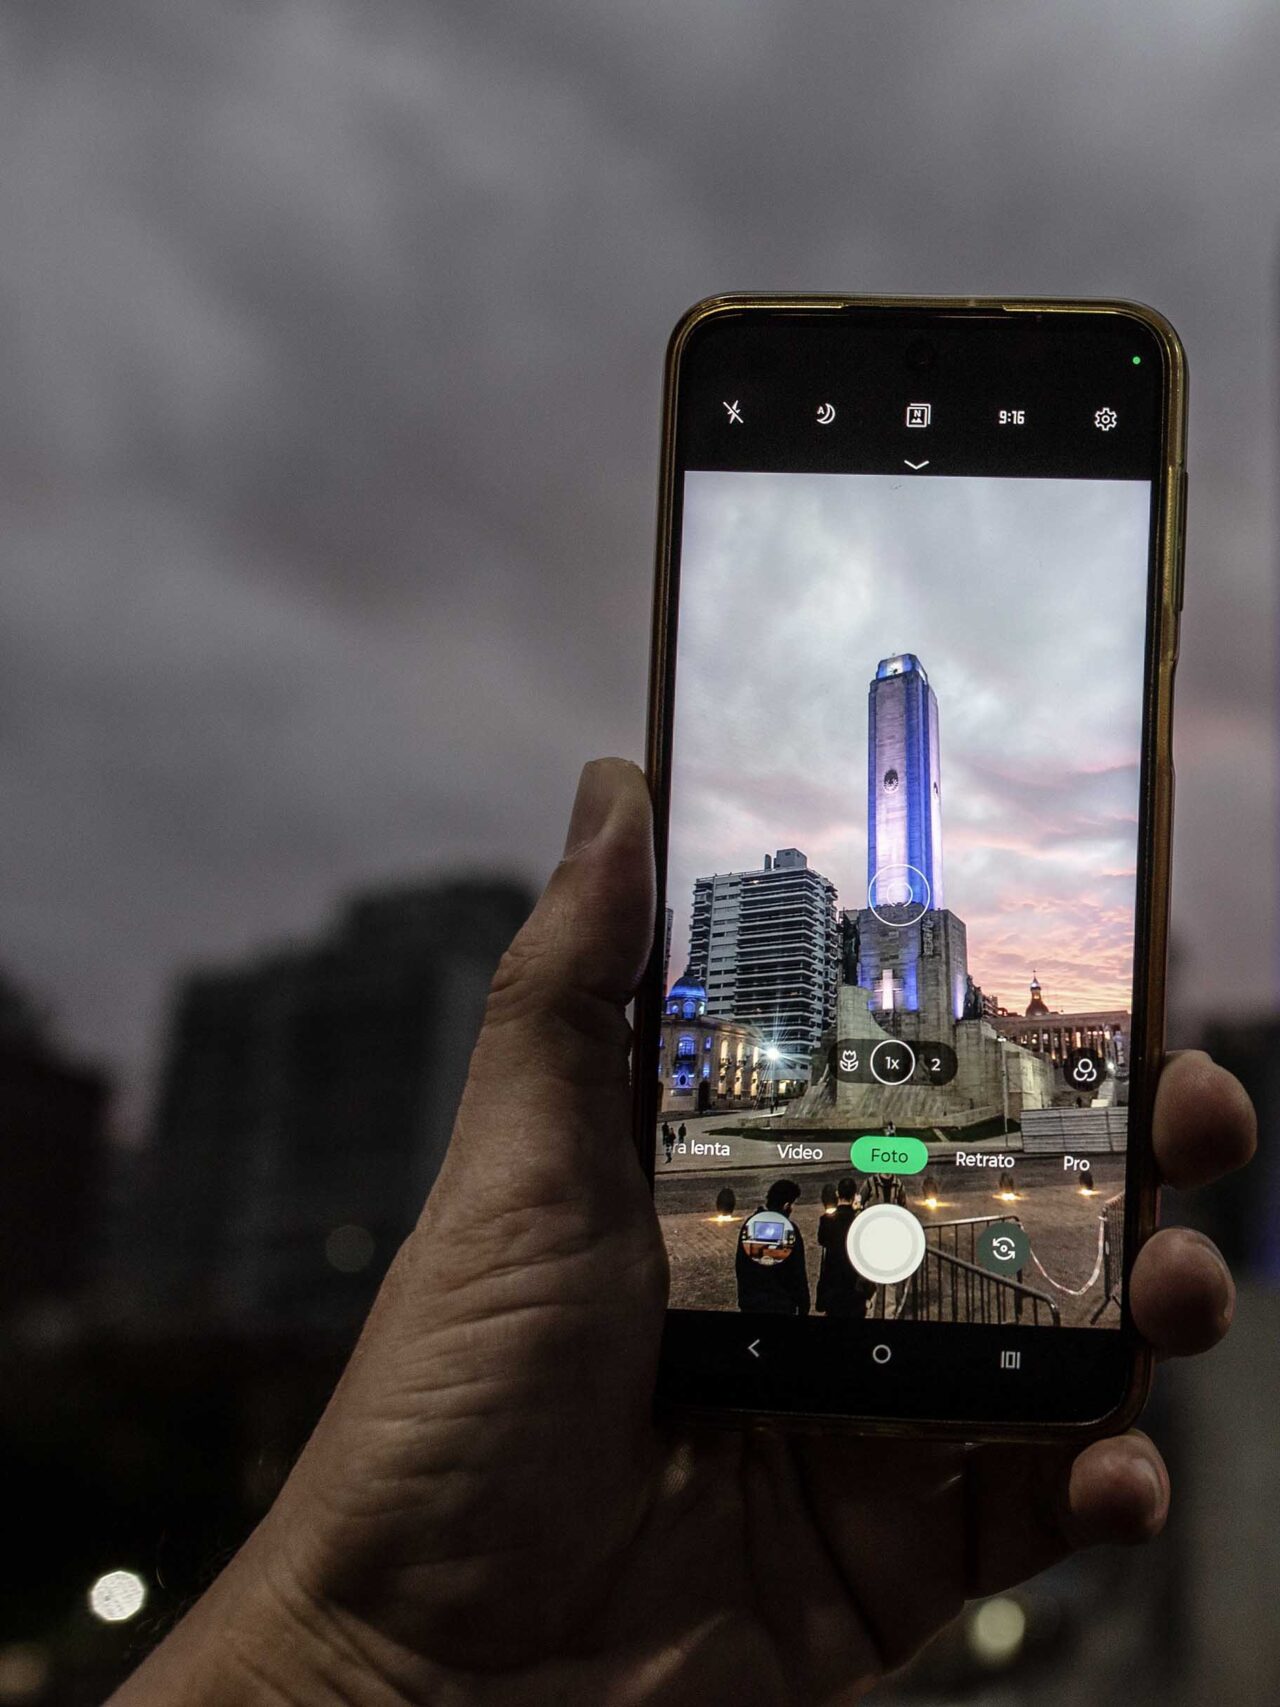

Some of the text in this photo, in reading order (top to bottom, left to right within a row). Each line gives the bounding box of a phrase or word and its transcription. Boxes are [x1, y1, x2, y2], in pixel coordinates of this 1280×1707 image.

[913, 409, 922, 418] N
[999, 410, 1026, 425] 9:16
[885, 1056, 900, 1070] 1x
[931, 1058, 941, 1071] 2
[691, 1139, 731, 1156] lenta
[871, 1148, 909, 1163] Foto
[955, 1151, 1015, 1169] Retrato
[1063, 1155, 1091, 1172] Pro
